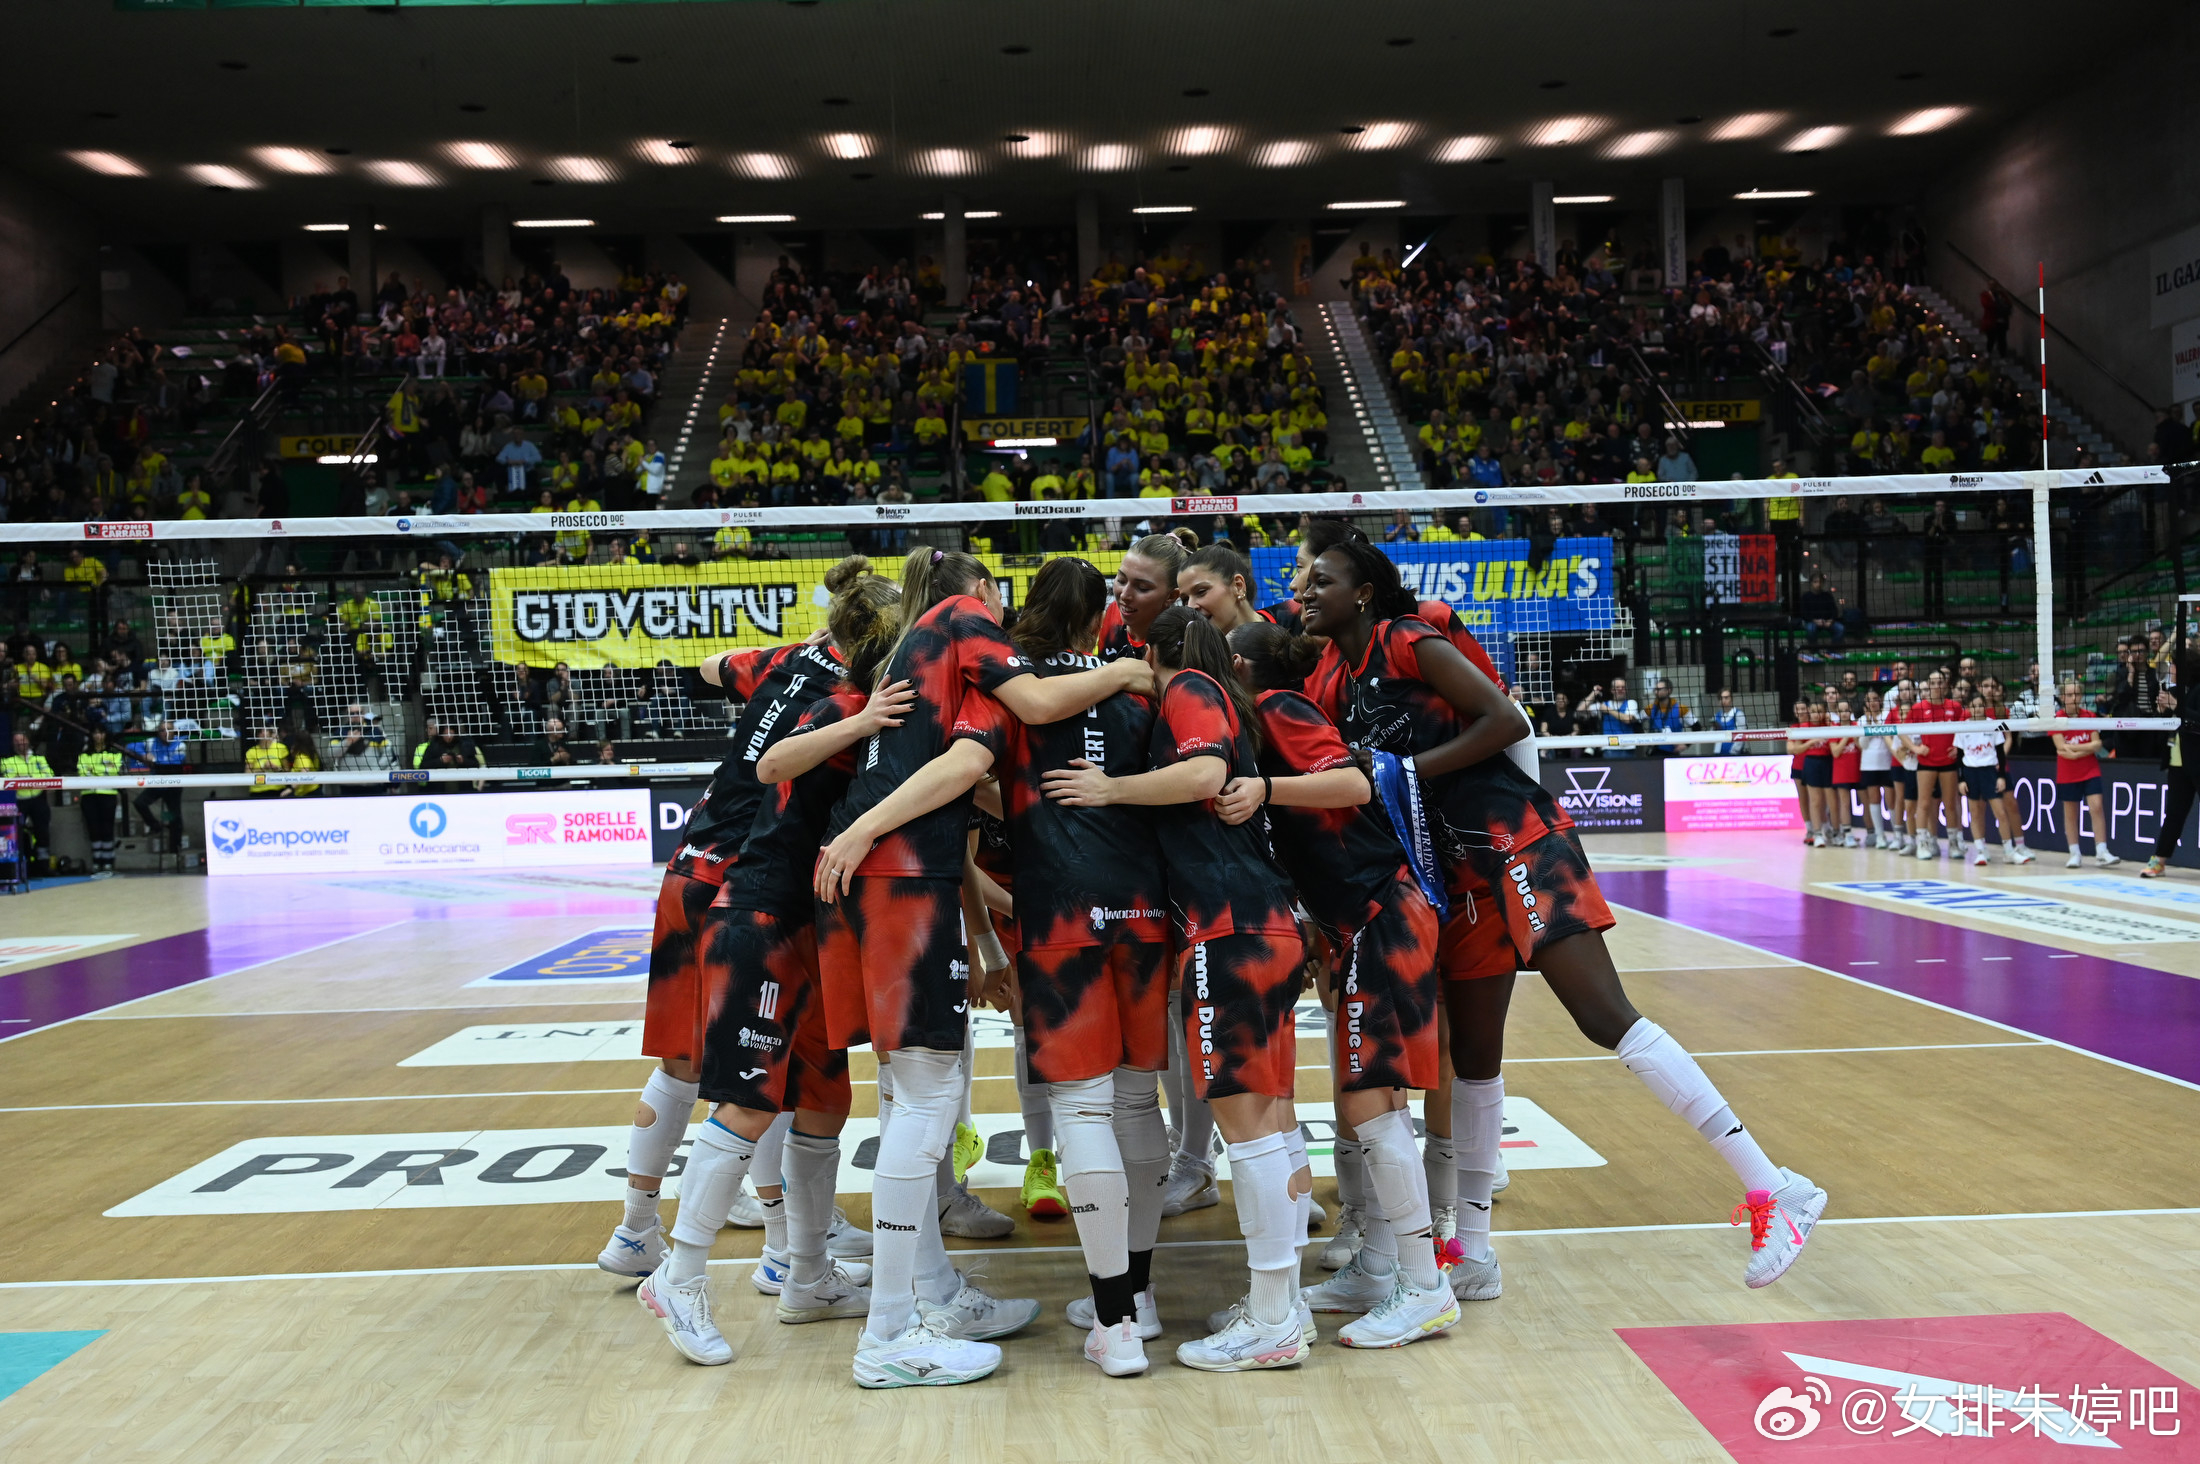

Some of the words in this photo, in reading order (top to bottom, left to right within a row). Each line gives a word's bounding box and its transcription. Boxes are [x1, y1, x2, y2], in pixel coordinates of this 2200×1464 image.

[2156, 273, 2172, 296] IL
[979, 421, 1074, 438] COLFERT
[1624, 485, 1681, 498] PROSECCO
[1682, 485, 1696, 493] DOC
[1188, 504, 1235, 512] CARRARO
[551, 515, 608, 528] PROSECCO
[610, 514, 625, 523] DOC
[101, 529, 151, 538] CARRARO
[743, 699, 787, 763] WOLOSZ
[1198, 741, 1224, 751] FININT
[391, 771, 428, 781] FINECO
[564, 811, 637, 827] SORELLE
[247, 828, 350, 848] Benpower
[564, 828, 648, 843] RAMONDA
[396, 843, 410, 855] Di
[413, 843, 481, 855] Meccanica
[1834, 880, 2064, 909] BAXI
[1142, 906, 1167, 920] Volley
[758, 980, 780, 1020] 10
[749, 1040, 774, 1053] Volley
[876, 1219, 918, 1231] Joma
